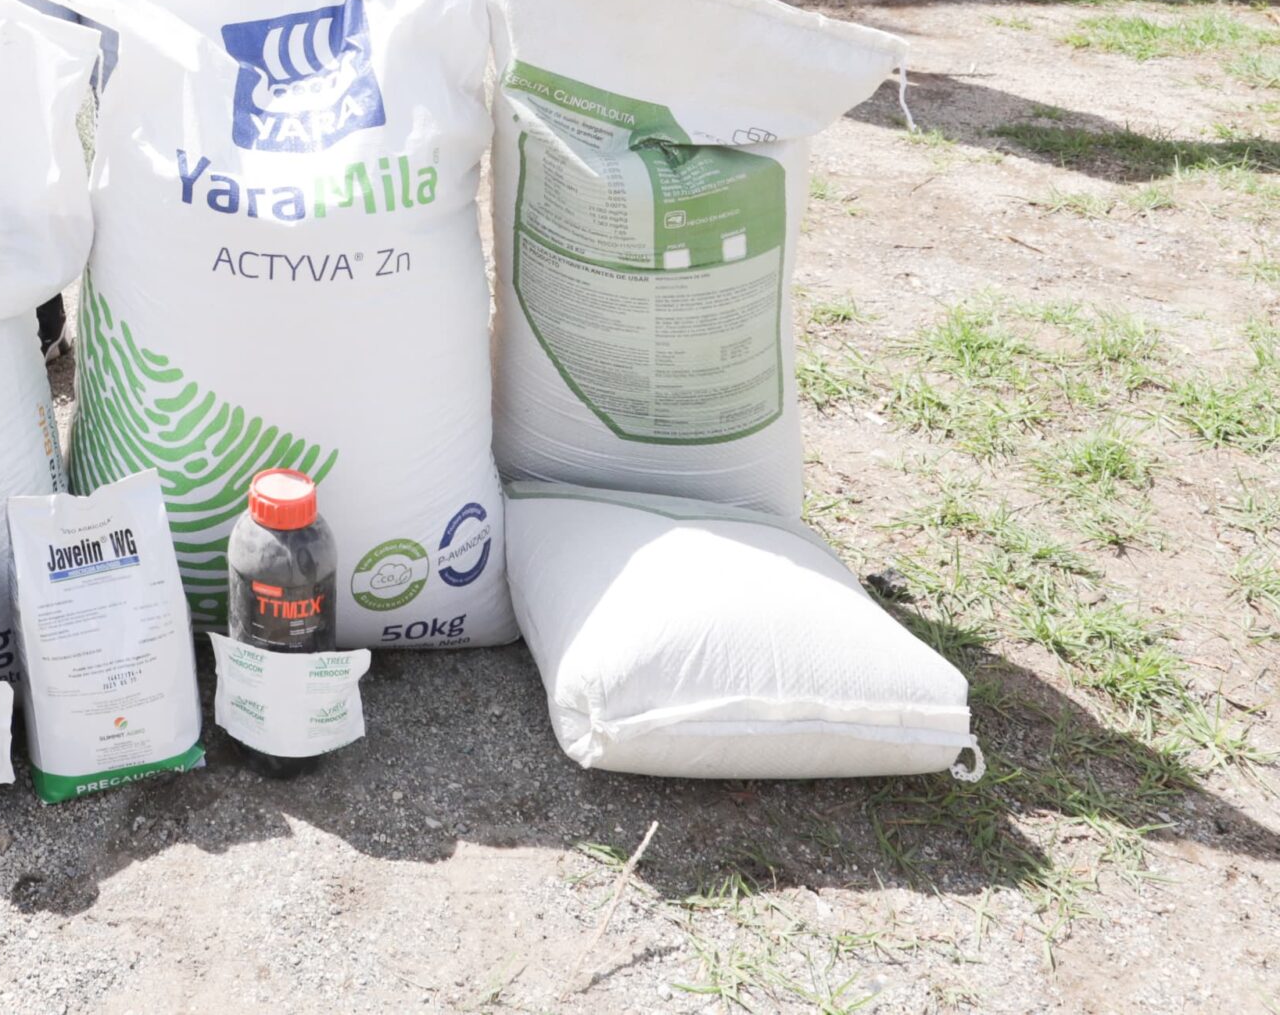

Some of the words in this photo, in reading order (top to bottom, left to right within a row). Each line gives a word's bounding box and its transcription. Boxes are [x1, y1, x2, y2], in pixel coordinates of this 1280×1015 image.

[250, 94, 364, 142] YARA
[376, 248, 411, 277] Zn
[109, 528, 138, 558] WG
[380, 614, 467, 642] 50kg
[76, 765, 185, 795] PRECAUCN
